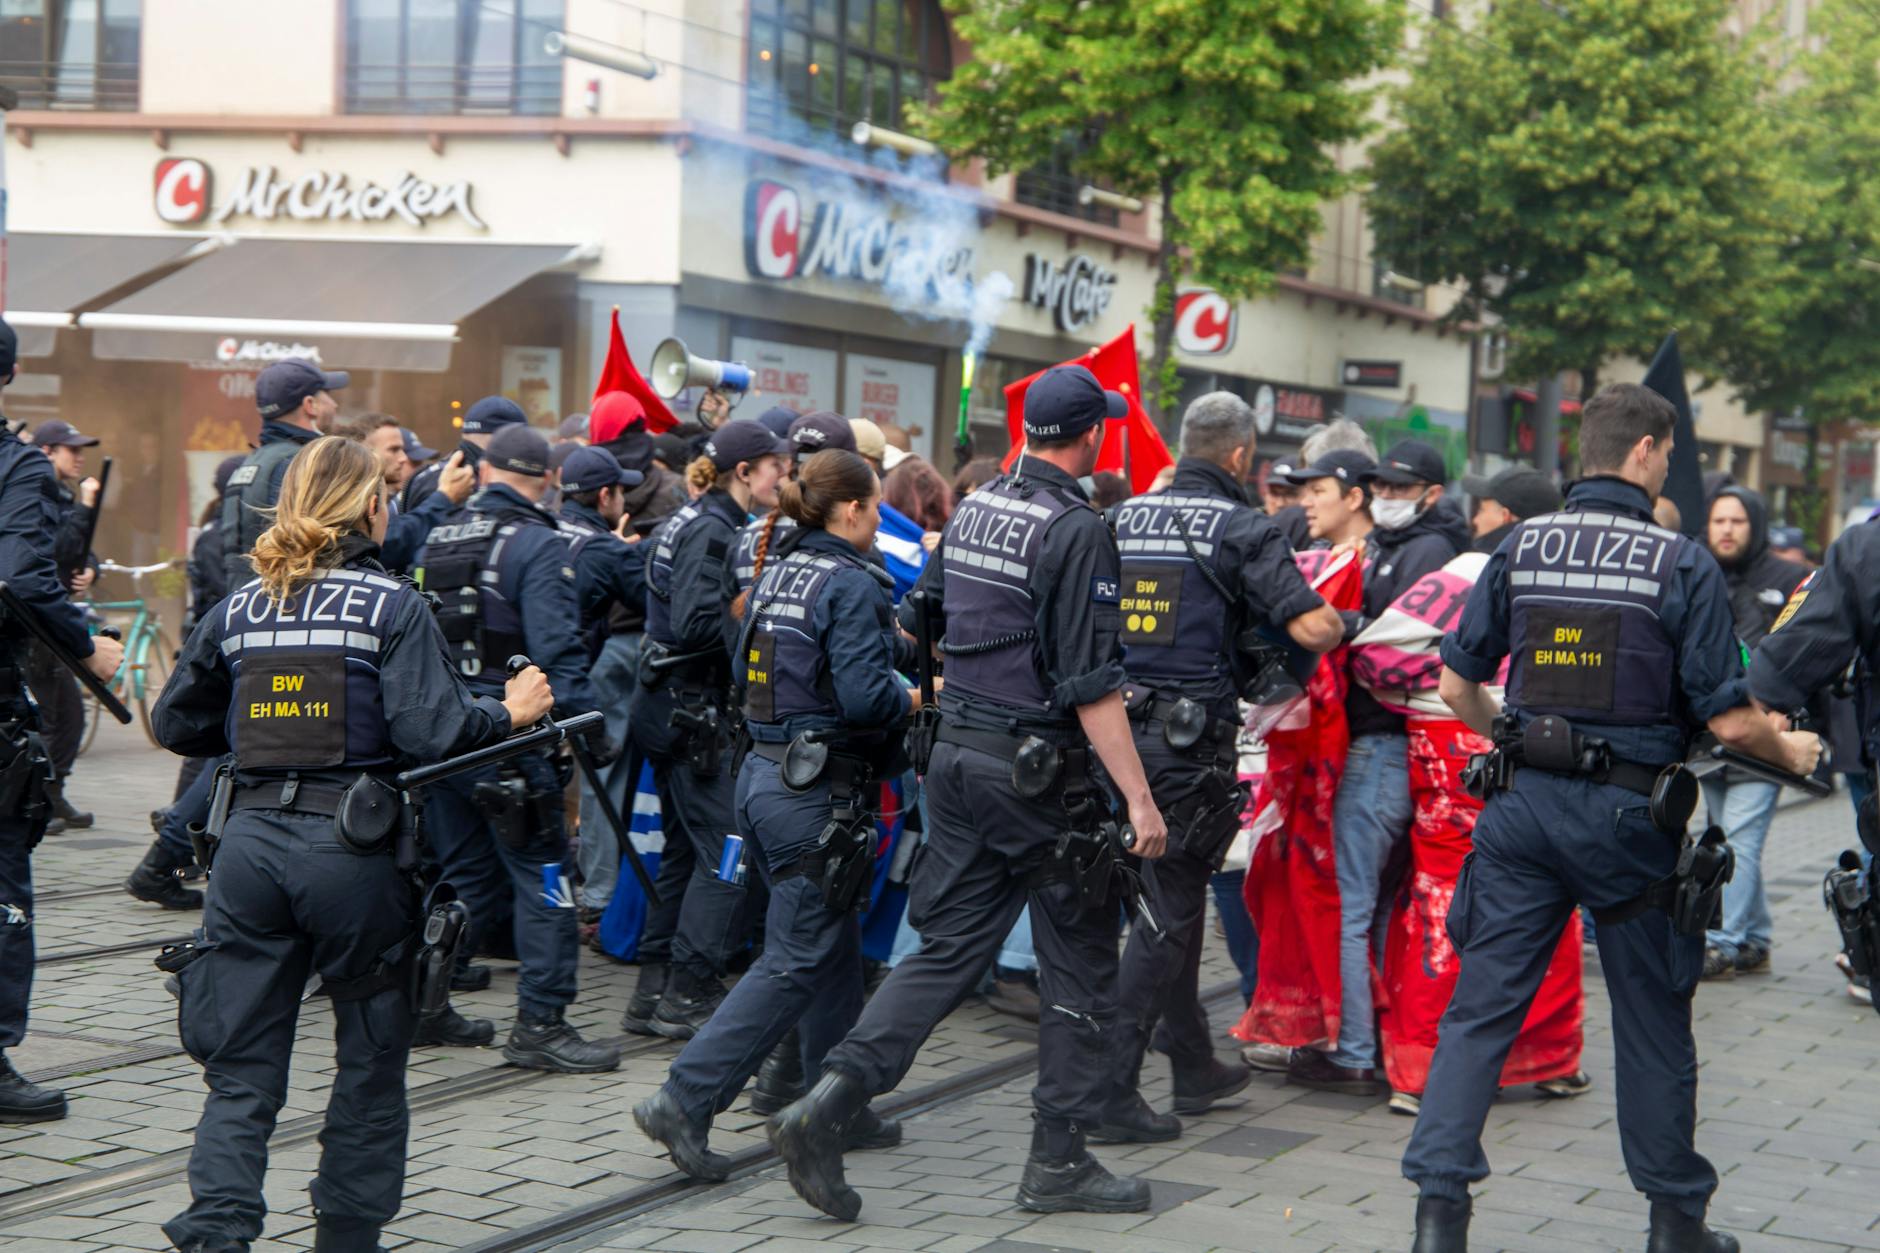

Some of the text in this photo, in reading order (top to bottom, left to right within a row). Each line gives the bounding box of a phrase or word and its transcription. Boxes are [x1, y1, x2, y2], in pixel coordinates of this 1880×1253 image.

[947, 506, 1036, 557] POLIZEI
[1115, 508, 1222, 540] POLIZEI
[1515, 528, 1667, 574] POLIZEI
[1097, 582, 1117, 597] FLT
[1136, 580, 1158, 594] BW
[224, 583, 387, 631] POLIZEI
[1120, 598, 1170, 613] EH MA 111
[1554, 627, 1582, 643] BW
[1535, 650, 1602, 666] EH MA 111
[272, 675, 304, 692] BW
[250, 702, 330, 719] EH MA 111
